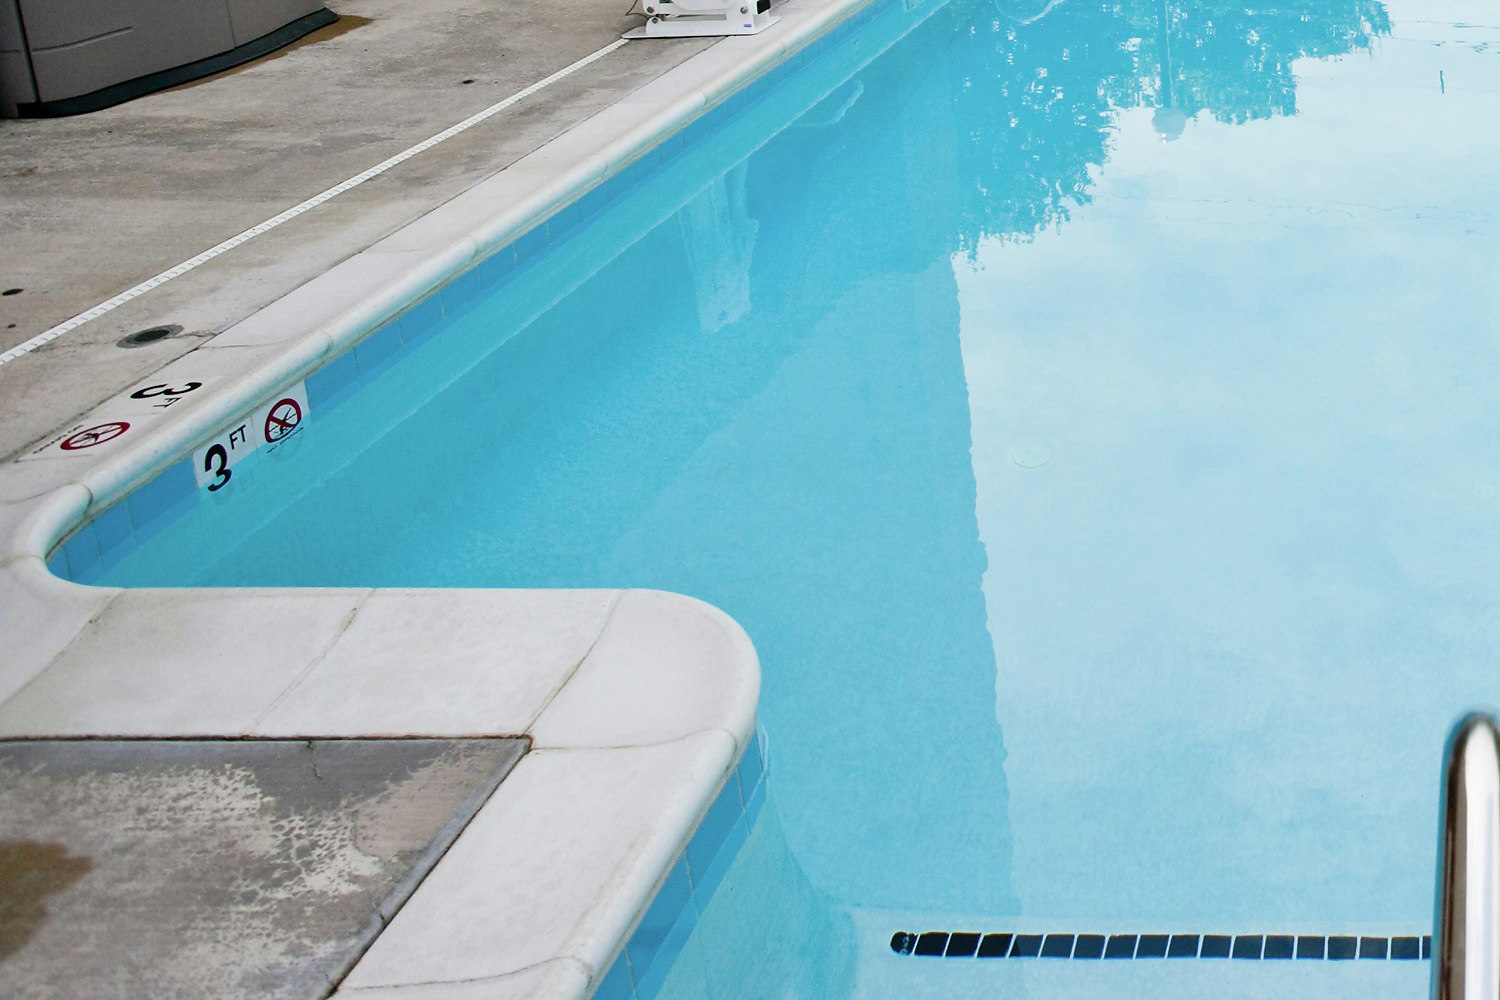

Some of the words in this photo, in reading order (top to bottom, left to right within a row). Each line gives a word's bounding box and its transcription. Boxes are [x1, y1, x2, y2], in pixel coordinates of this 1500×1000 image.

[130, 381, 203, 399] 3
[204, 443, 233, 492] 3
[229, 424, 248, 451] FT
